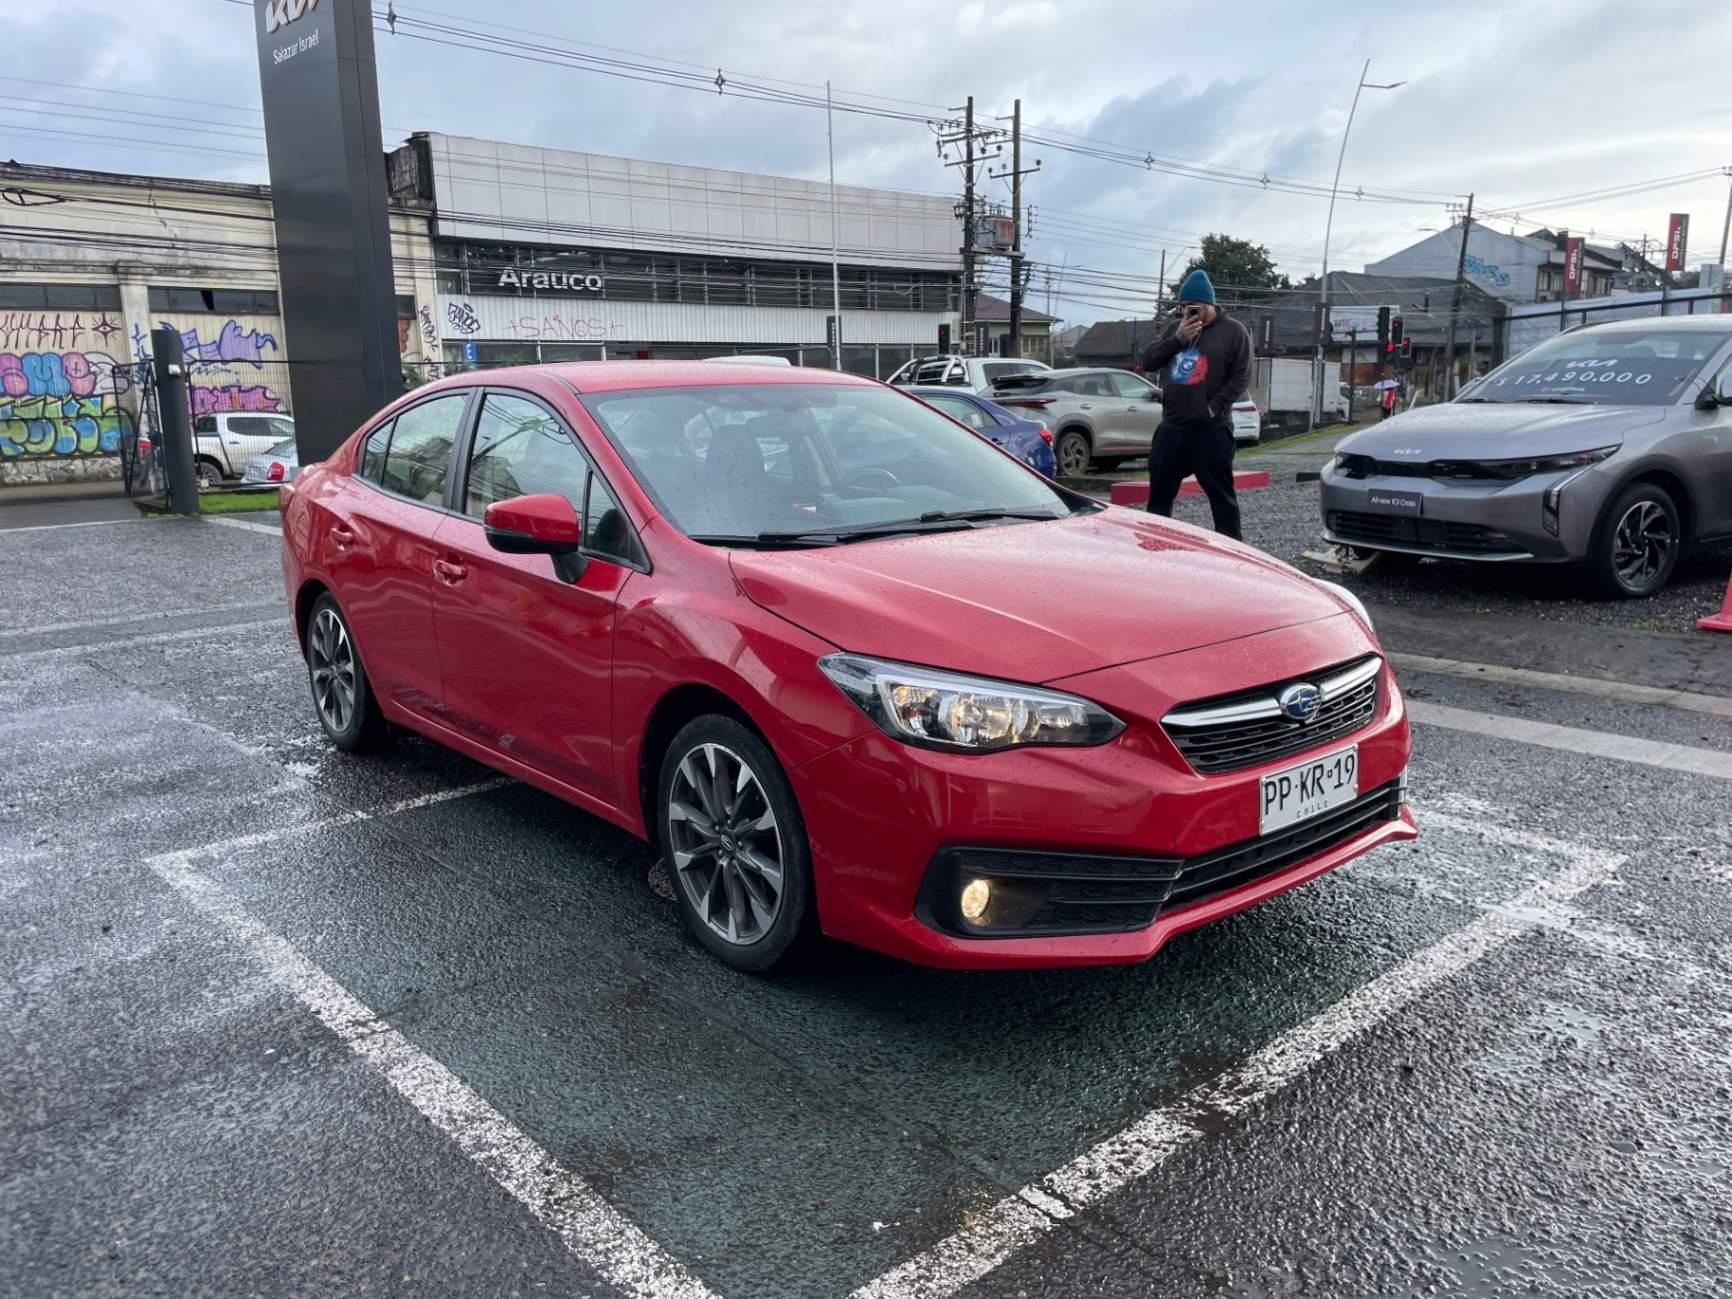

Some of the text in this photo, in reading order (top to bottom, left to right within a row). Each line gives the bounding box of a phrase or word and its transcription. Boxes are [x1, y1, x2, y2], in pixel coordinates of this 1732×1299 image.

[273, 28, 319, 65] Salazar Israel
[498, 266, 602, 291] Arauco
[1296, 800, 1329, 818] CHILE
